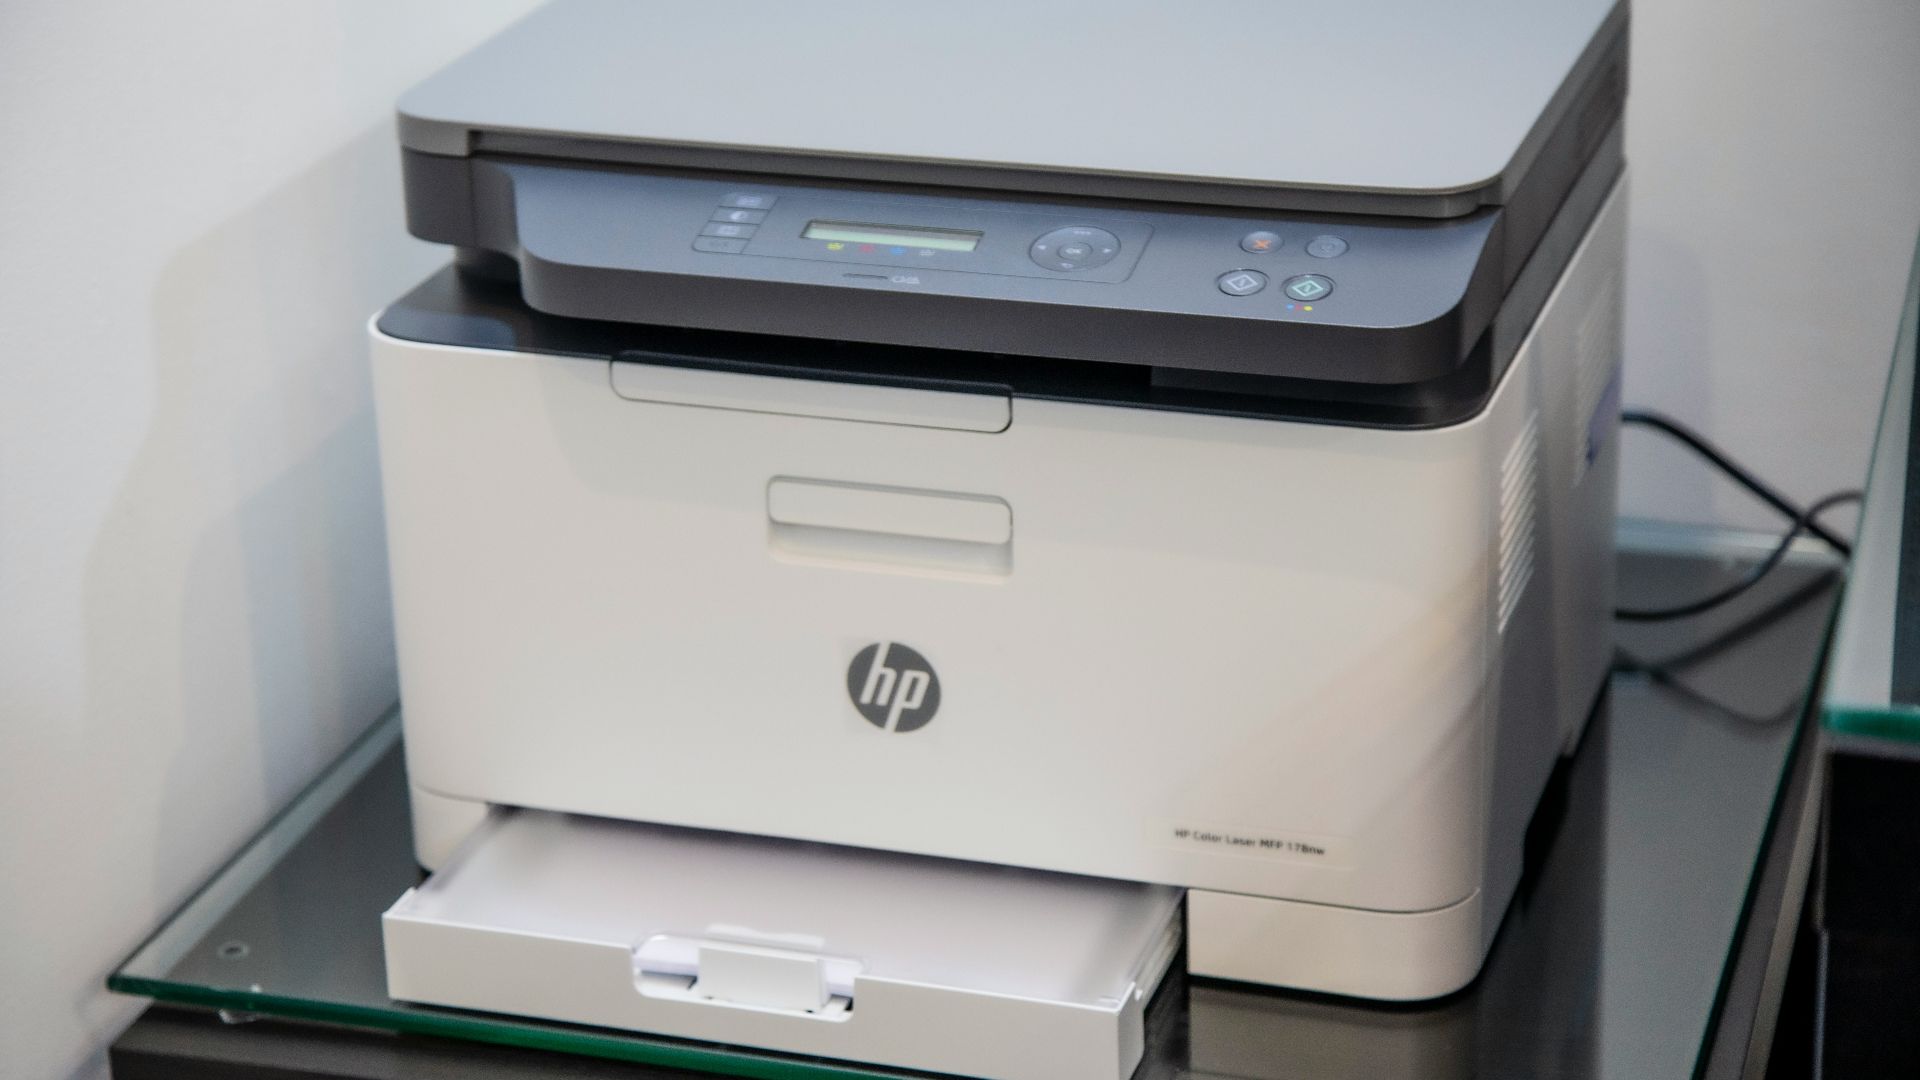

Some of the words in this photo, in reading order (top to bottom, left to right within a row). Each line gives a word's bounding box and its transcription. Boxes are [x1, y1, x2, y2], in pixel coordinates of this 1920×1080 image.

[858, 641, 931, 732] hp
[1175, 828, 1190, 838] HP
[1193, 830, 1222, 842] Color
[1226, 834, 1255, 847] Laser
[1259, 838, 1284, 849] MFP
[1288, 842, 1326, 855] 178nw
